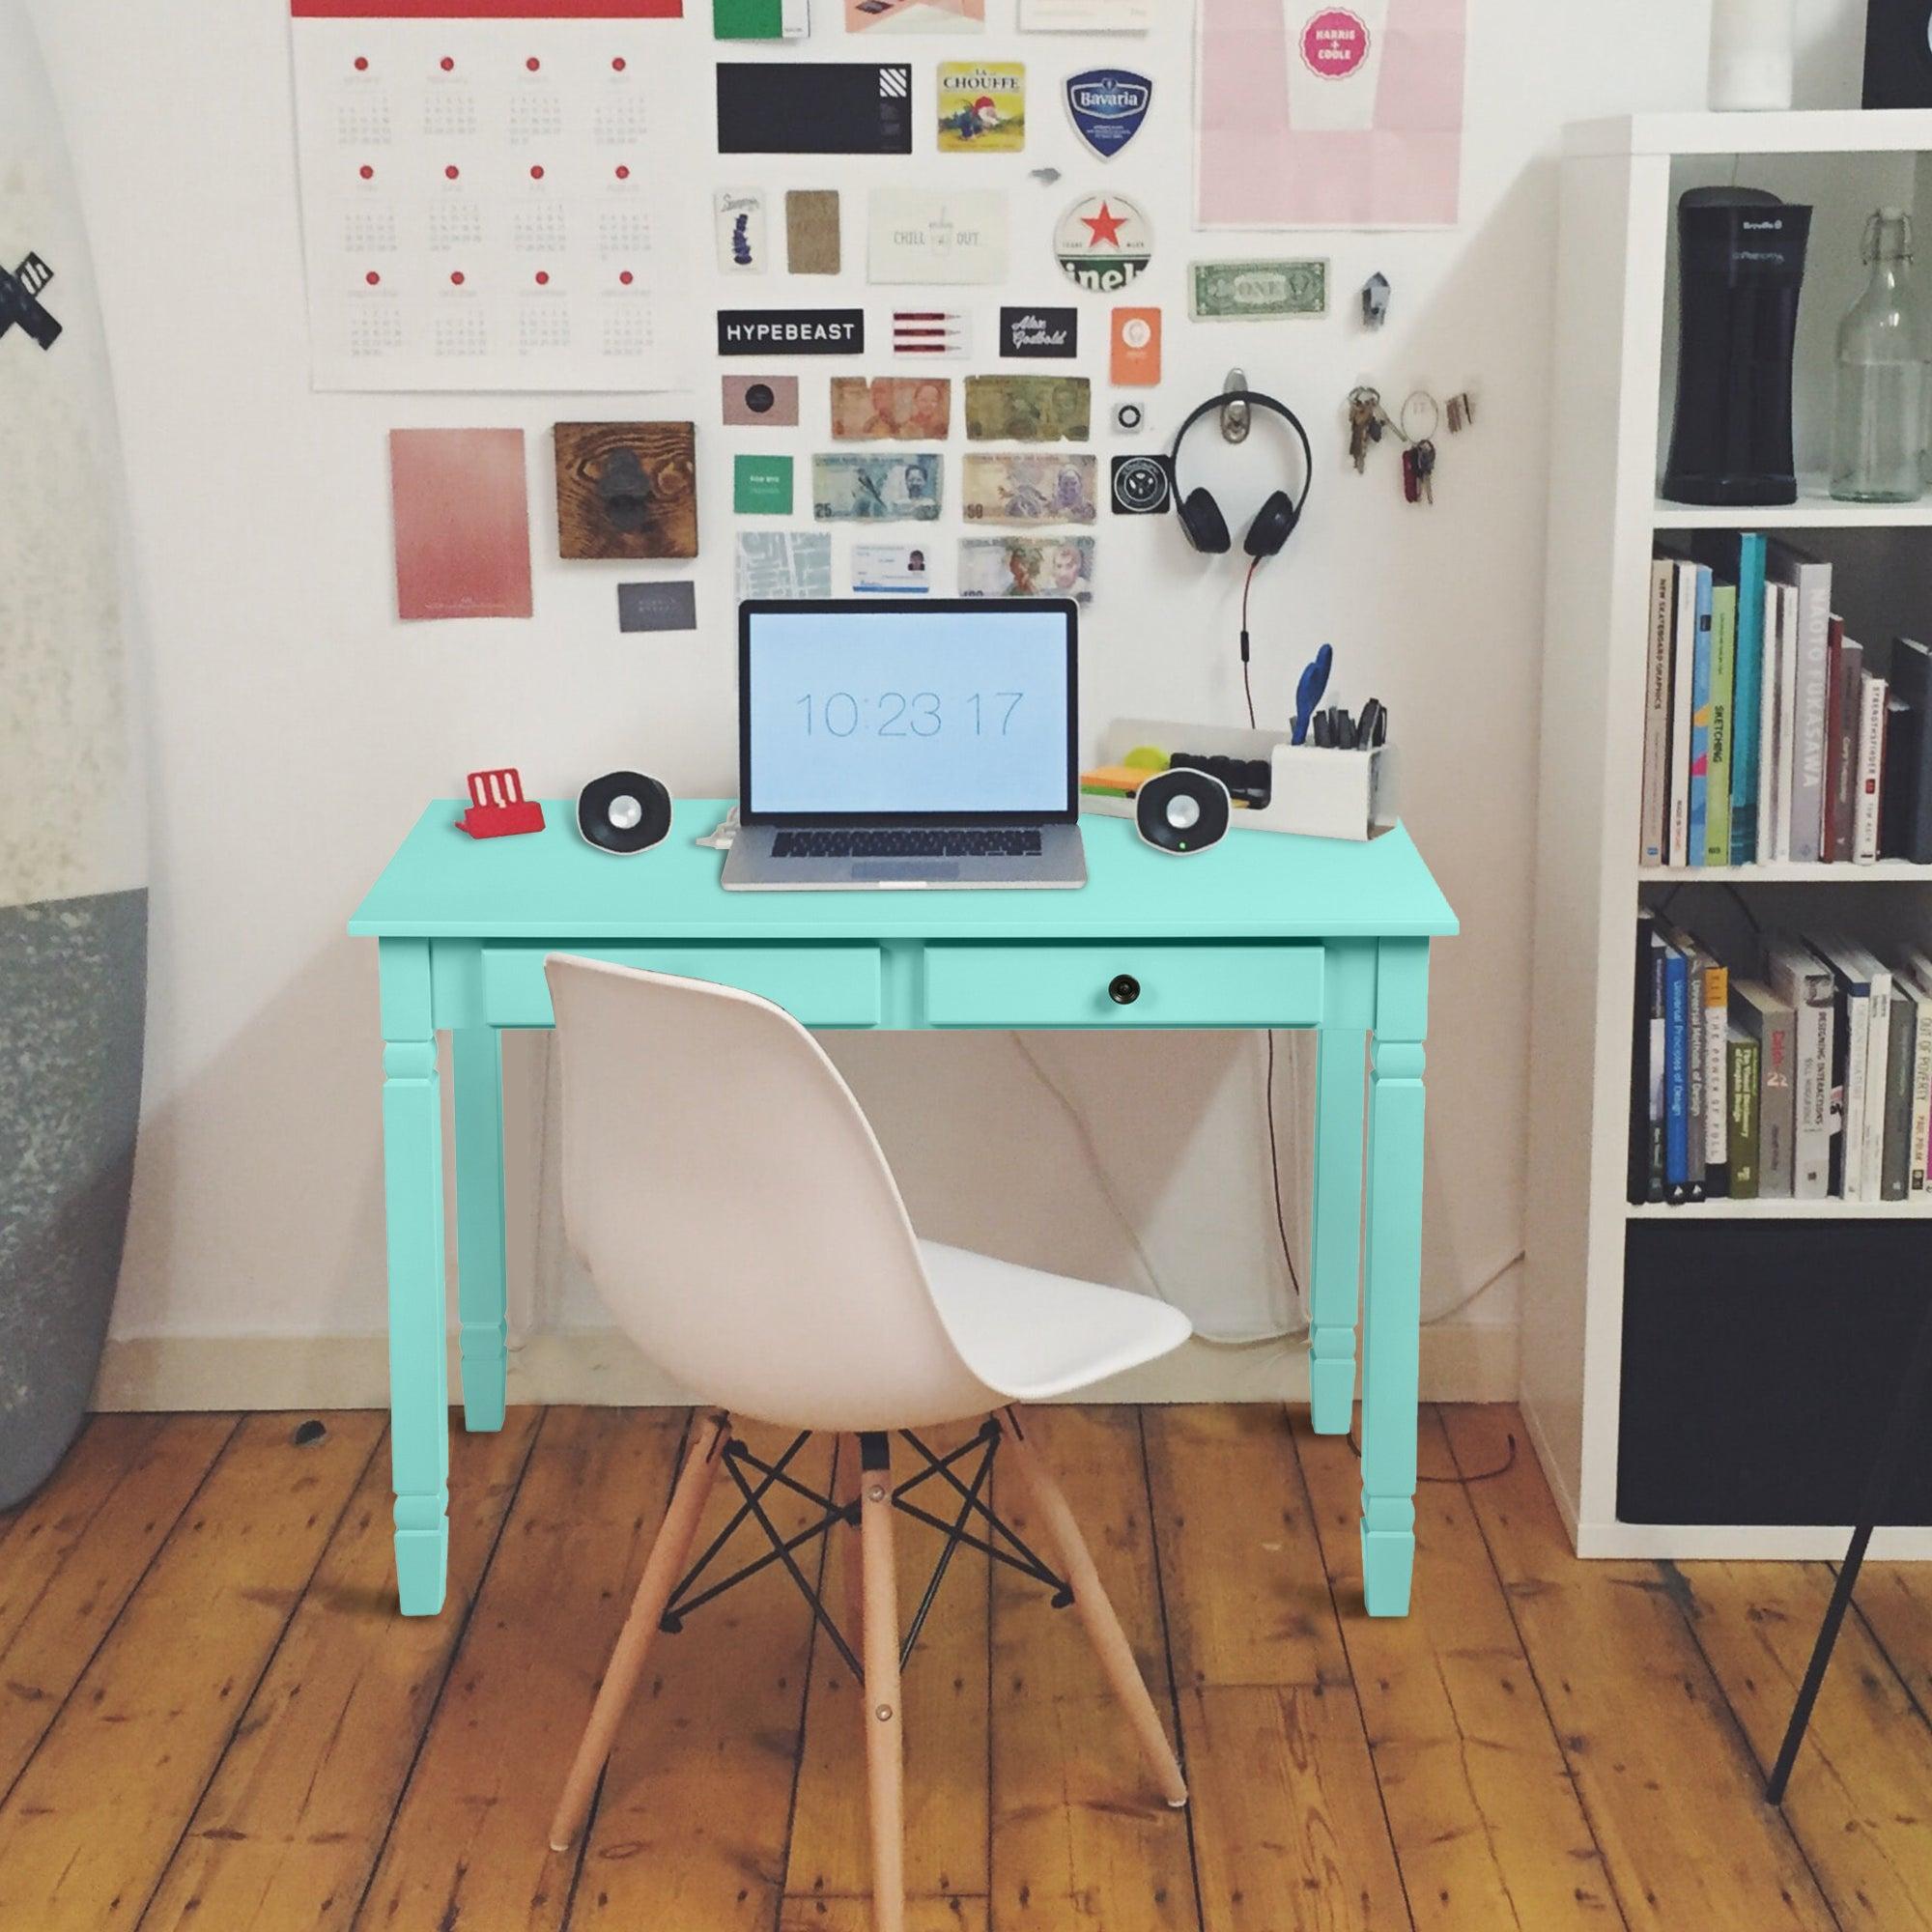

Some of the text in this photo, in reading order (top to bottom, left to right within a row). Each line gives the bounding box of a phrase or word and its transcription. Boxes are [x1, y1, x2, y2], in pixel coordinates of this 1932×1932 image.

[1316, 30, 1355, 41] HARRIS
[943, 75, 1020, 90] CHOUFFE
[1080, 91, 1138, 107] Bavaria
[894, 231, 980, 245] CHILL OUT
[1237, 280, 1284, 296] ONE
[726, 324, 855, 341] HYPEBEAST
[814, 503, 832, 518] 25
[966, 503, 983, 520] 50
[1654, 579, 1667, 709] NEW SKATEBOARD GRAPHICS
[1803, 588, 1826, 787] NAOTO FUKASAWA
[797, 692, 1024, 737] 10:23 17
[1867, 686, 1881, 775] STRENGTHSFINDER
[1713, 705, 1724, 763] SKETCHING
[1711, 1015, 1719, 1040] THE
[1671, 980, 1683, 1116] Universal Principles of Design
[1690, 980, 1701, 1116] Universal Methods of Design
[1916, 1018, 1932, 1100] OUT OF POVERTY
[1711, 1048, 1719, 1092] POWER
[1816, 1012, 1826, 1124] DESIGNING INTERACTIONS
[1711, 1099, 1719, 1115] OF
